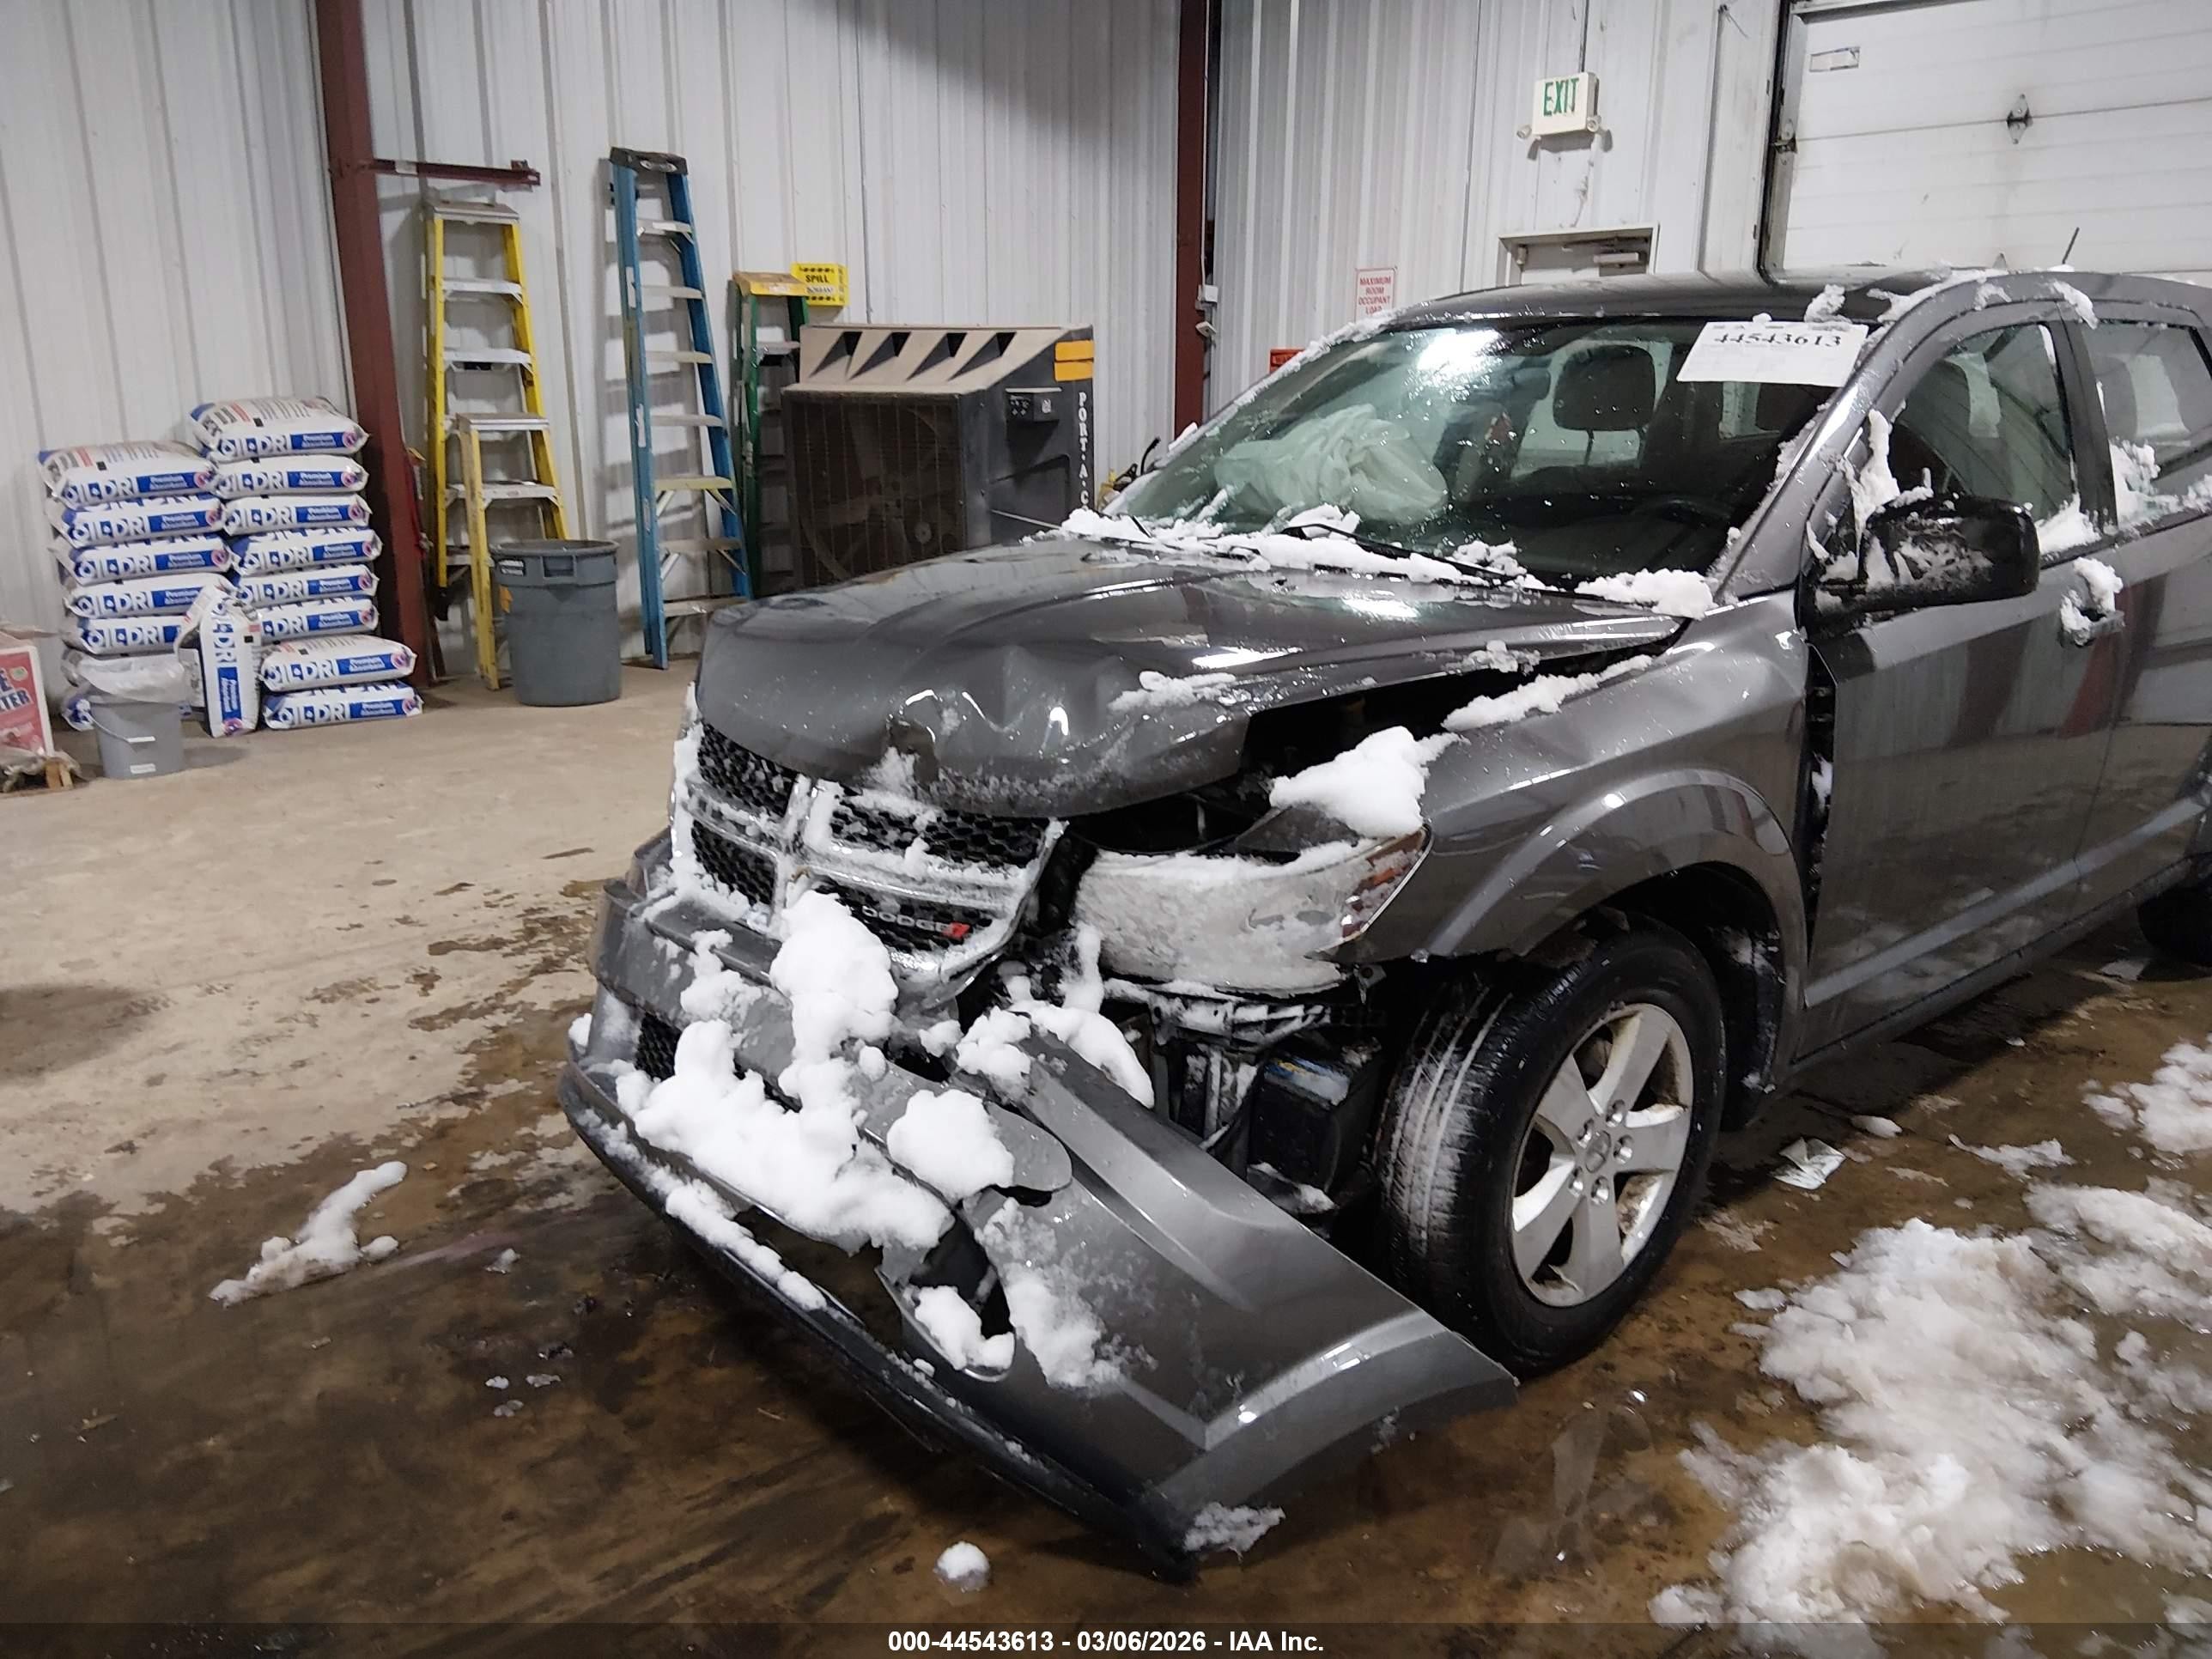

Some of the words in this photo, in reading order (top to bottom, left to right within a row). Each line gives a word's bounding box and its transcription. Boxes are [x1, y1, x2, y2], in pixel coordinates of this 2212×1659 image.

[1544, 78, 1579, 116] EXIT
[805, 275, 830, 283] SPILL
[1359, 276, 1391, 285] MAXIMUM
[1365, 287, 1384, 295] ROOM
